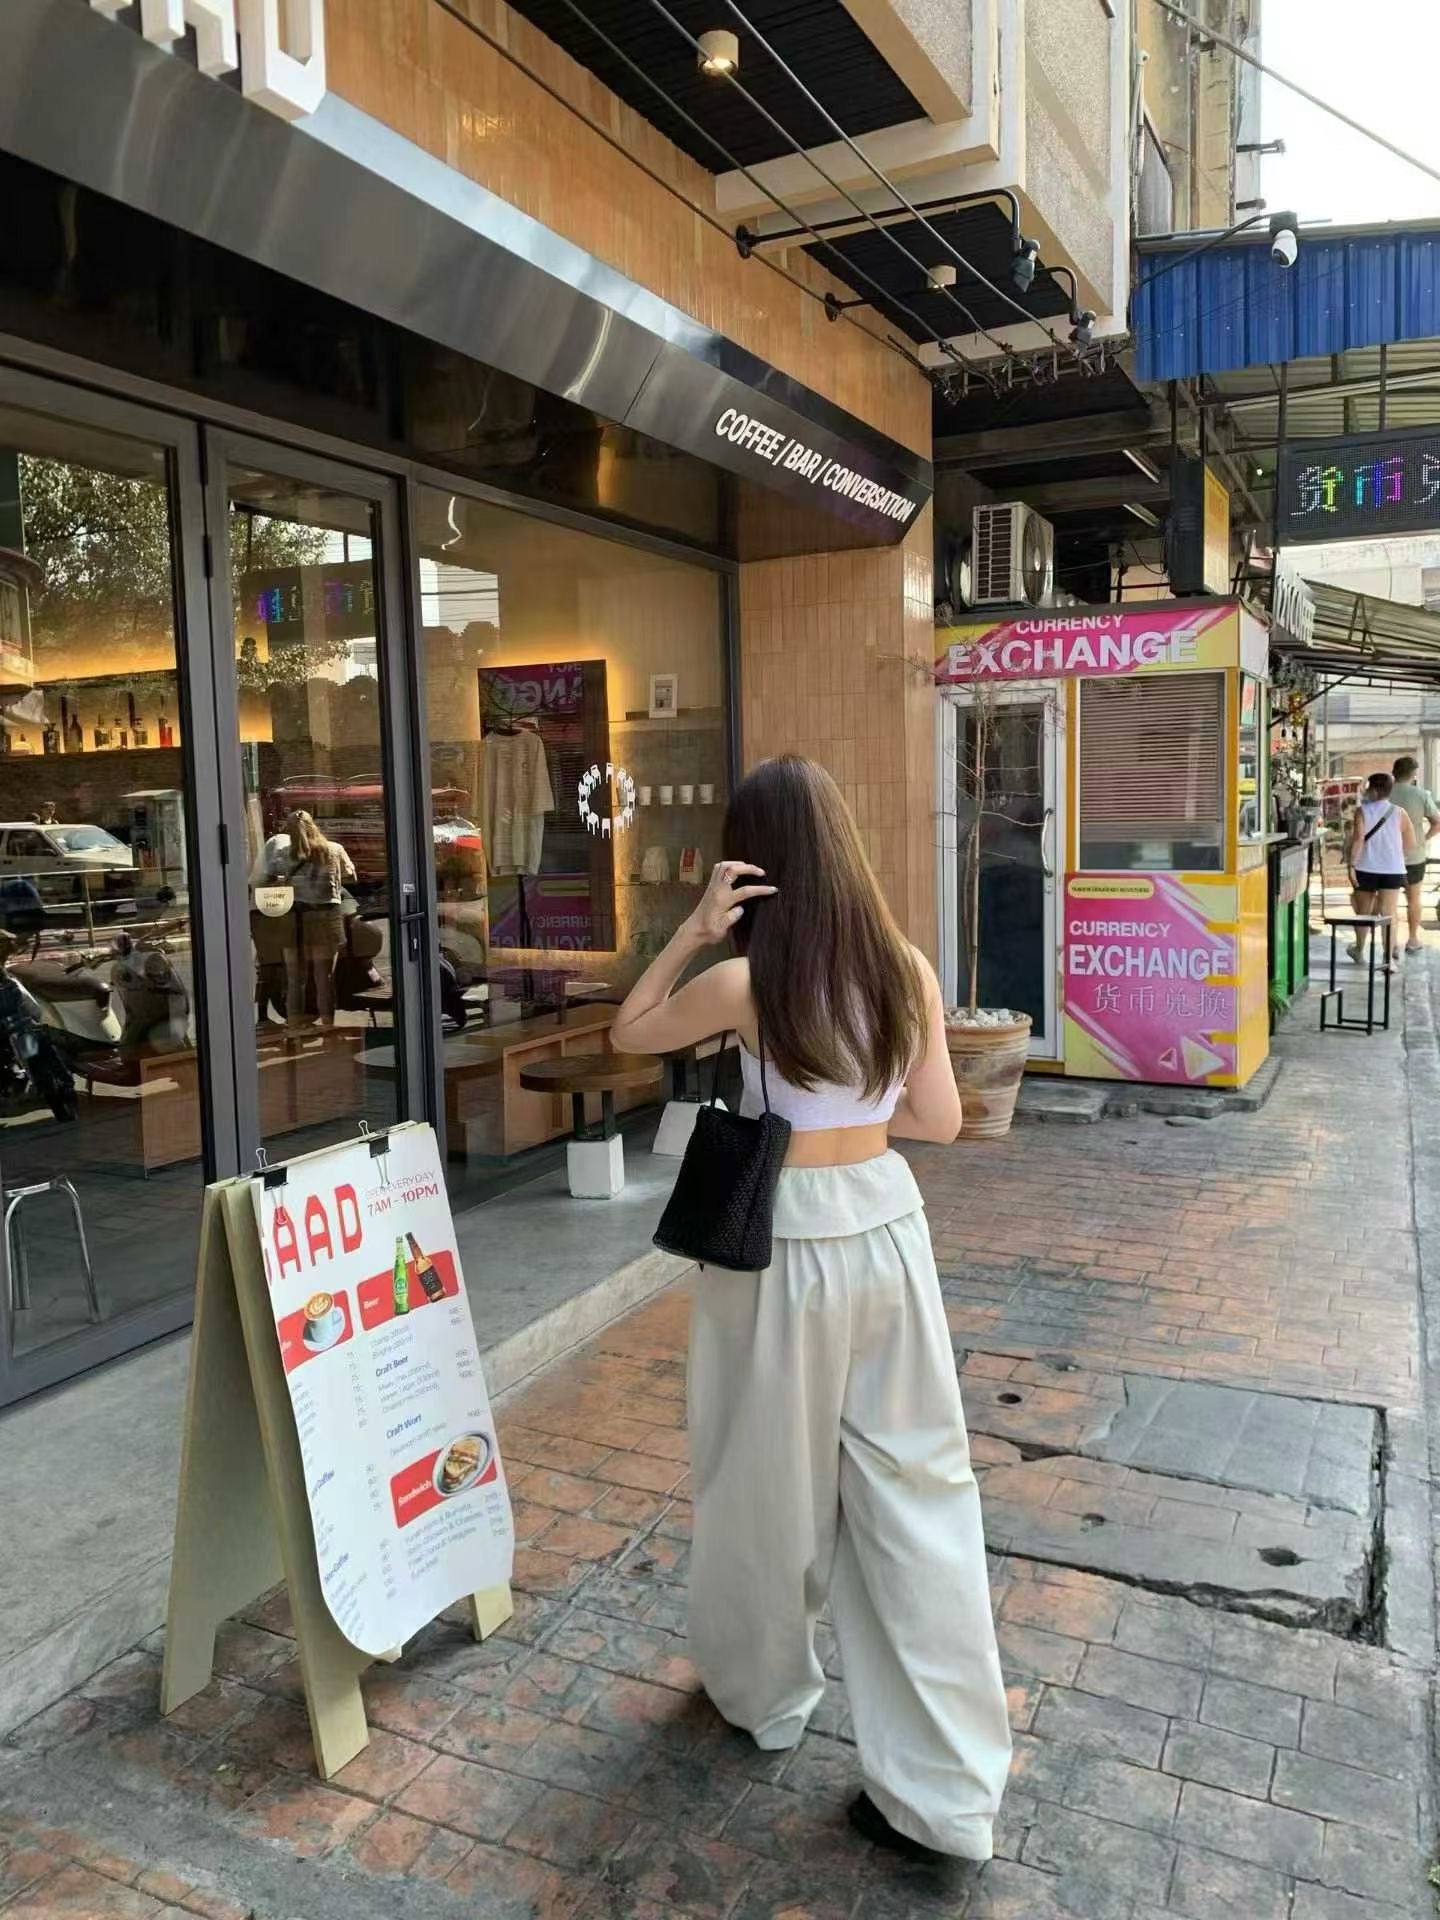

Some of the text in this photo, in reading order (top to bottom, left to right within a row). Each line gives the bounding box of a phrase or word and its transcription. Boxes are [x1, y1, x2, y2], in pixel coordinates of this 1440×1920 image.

[715, 408, 785, 459] COFFEE
[784, 444, 822, 478] BAR
[822, 463, 916, 523] CONVERSATION
[1016, 614, 1124, 634] CURRENCY
[947, 629, 1200, 676] EXCHANGE
[1069, 921, 1172, 938] CURRENCY
[1069, 944, 1230, 981] EXCHANGE
[1092, 984, 1229, 1019] 货币兑换
[367, 1201, 392, 1217] 7AM
[401, 1183, 440, 1204] 10PM
[265, 1183, 362, 1283] AAD
